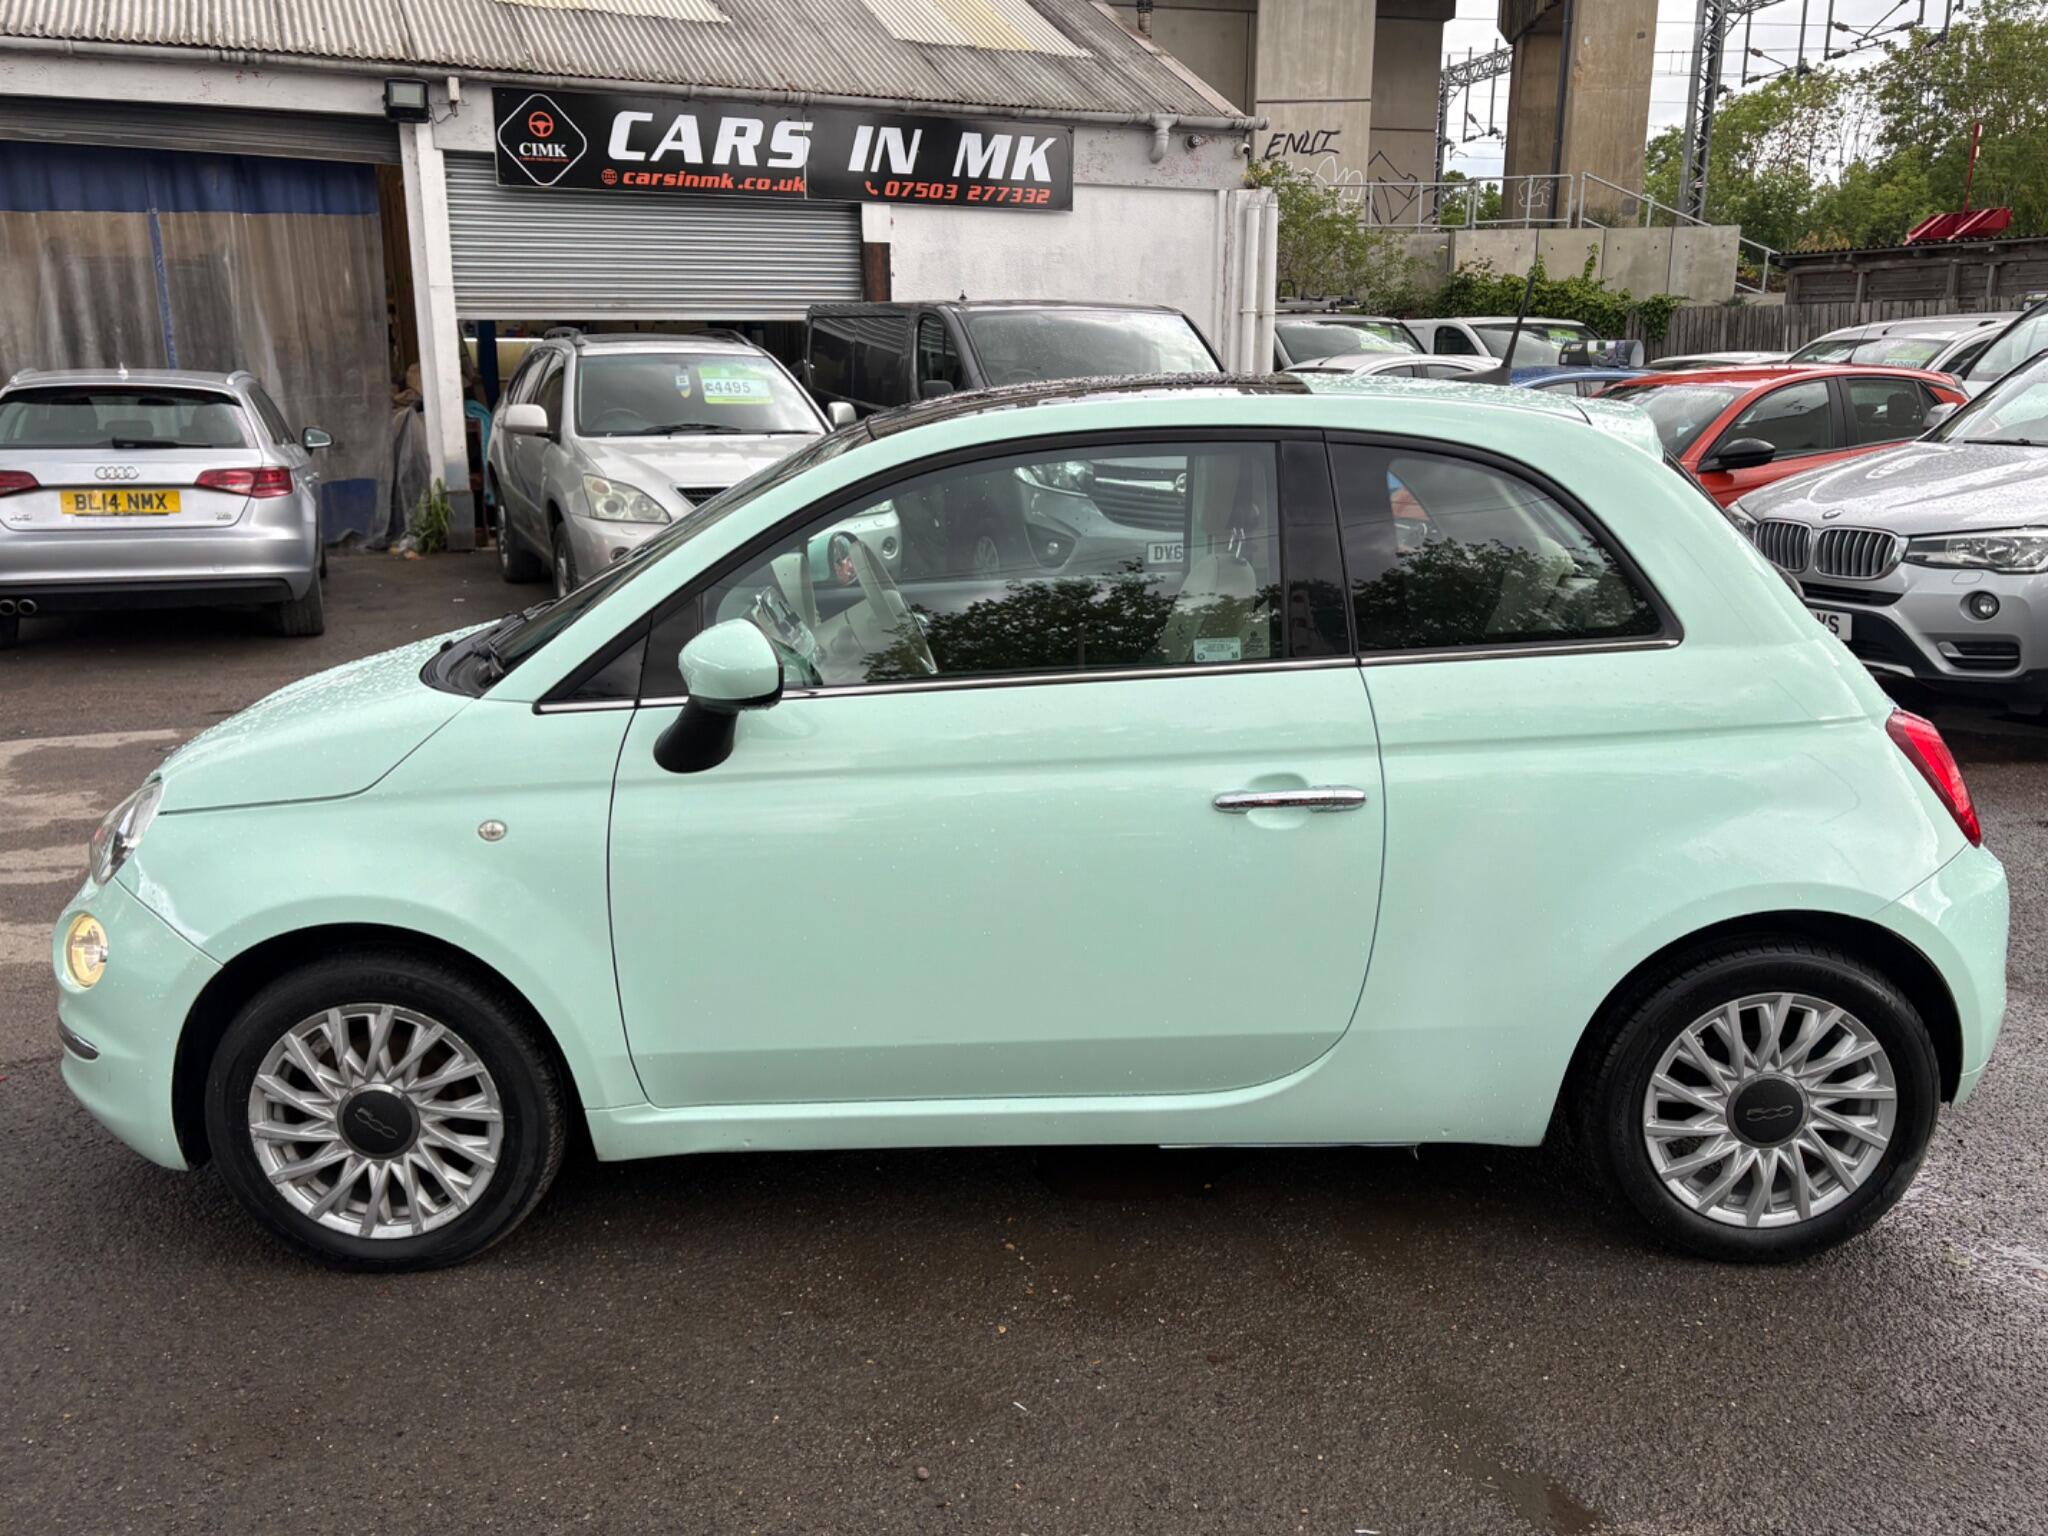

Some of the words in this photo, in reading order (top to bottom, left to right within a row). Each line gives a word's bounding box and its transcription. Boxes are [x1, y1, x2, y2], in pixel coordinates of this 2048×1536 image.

[519, 142, 567, 157] CIMK
[608, 110, 813, 169] CARS
[848, 125, 922, 175] IN
[952, 132, 1057, 182] MK
[622, 171, 806, 192] carsinmk.co.uk
[884, 180, 958, 200] 07503
[967, 185, 1051, 204] 277332
[704, 381, 751, 393] £4495
[74, 493, 120, 511] BL14
[128, 493, 168, 510] NMX
